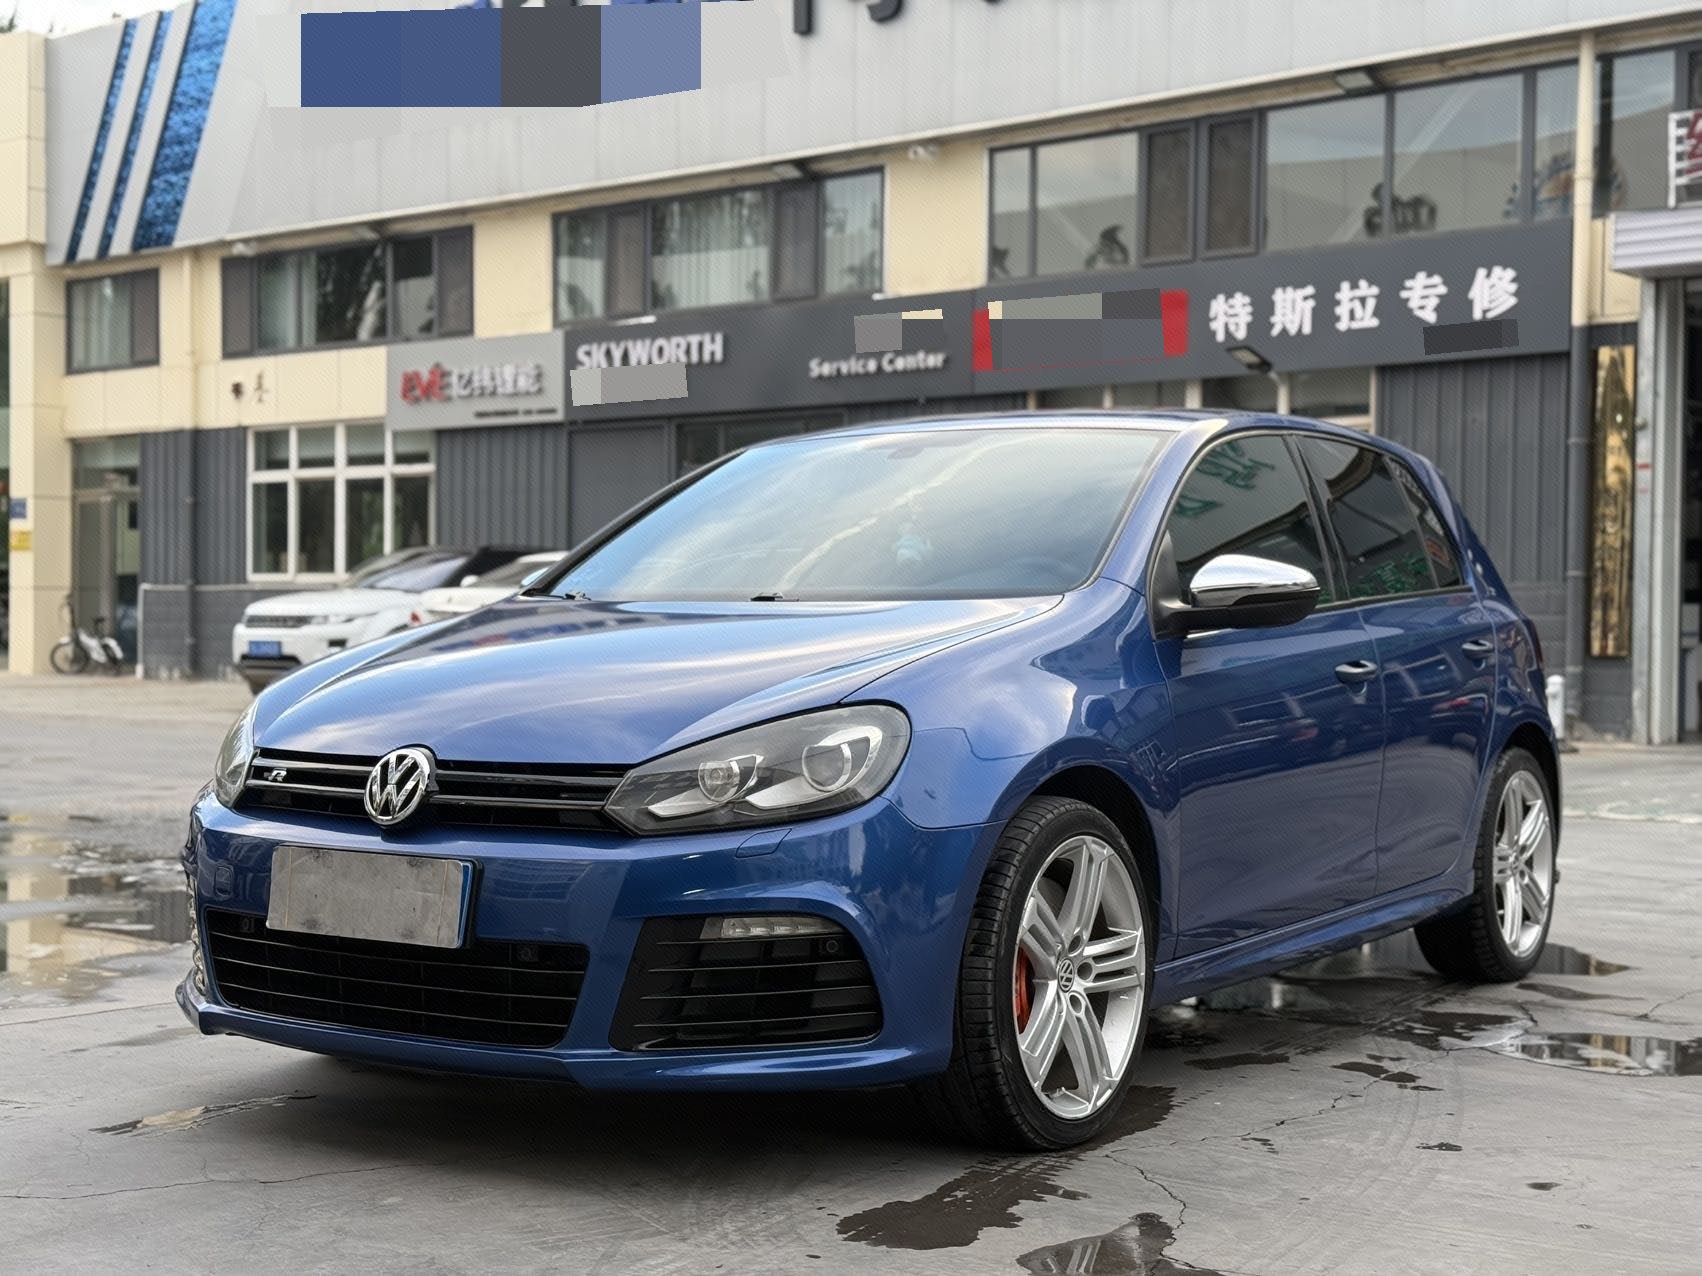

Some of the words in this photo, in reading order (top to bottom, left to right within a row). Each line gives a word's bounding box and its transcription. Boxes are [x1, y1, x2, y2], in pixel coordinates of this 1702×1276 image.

[1208, 265, 1519, 343] 特斯拉专修
[576, 332, 724, 370] SKYWORTH
[809, 357, 878, 379] Service
[881, 351, 946, 373] Center
